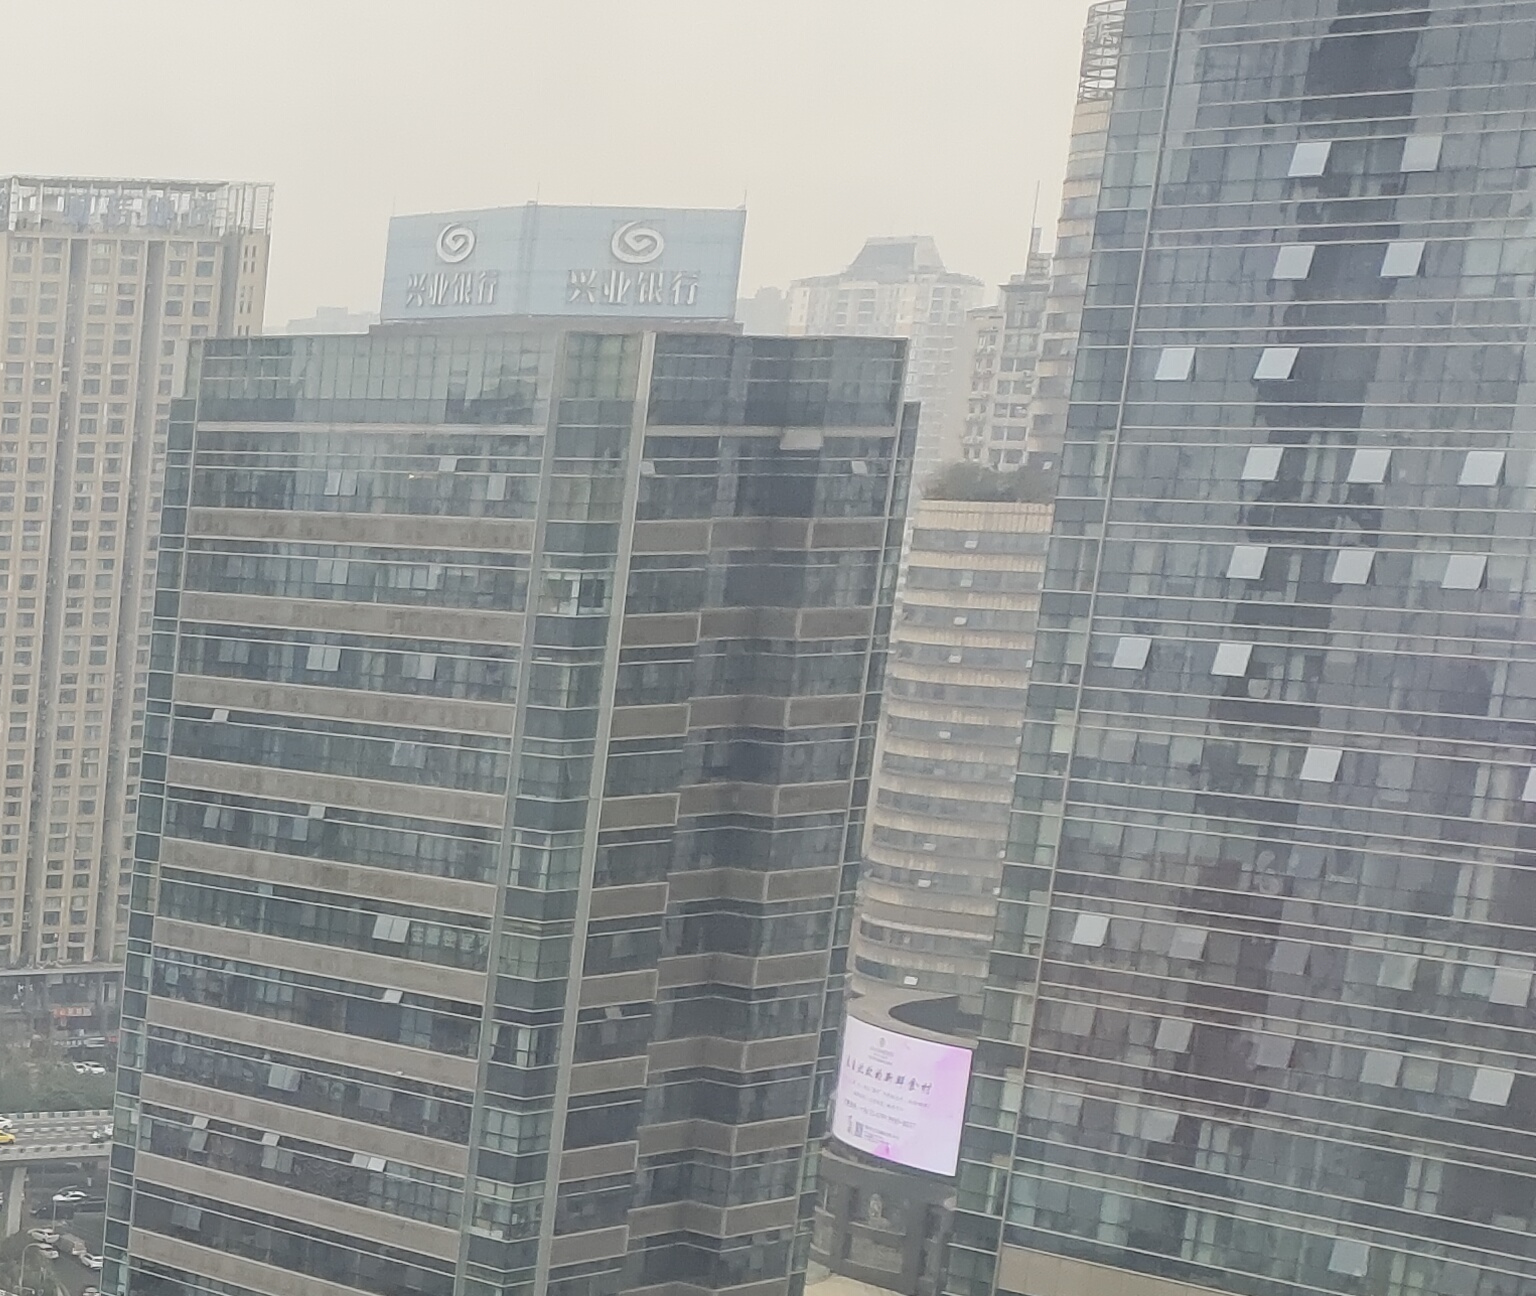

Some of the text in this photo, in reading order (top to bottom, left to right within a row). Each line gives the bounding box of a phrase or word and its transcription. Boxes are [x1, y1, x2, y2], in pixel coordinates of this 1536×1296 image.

[405, 272, 500, 307] 兴业银行
[567, 268, 700, 306] 兴业银行
